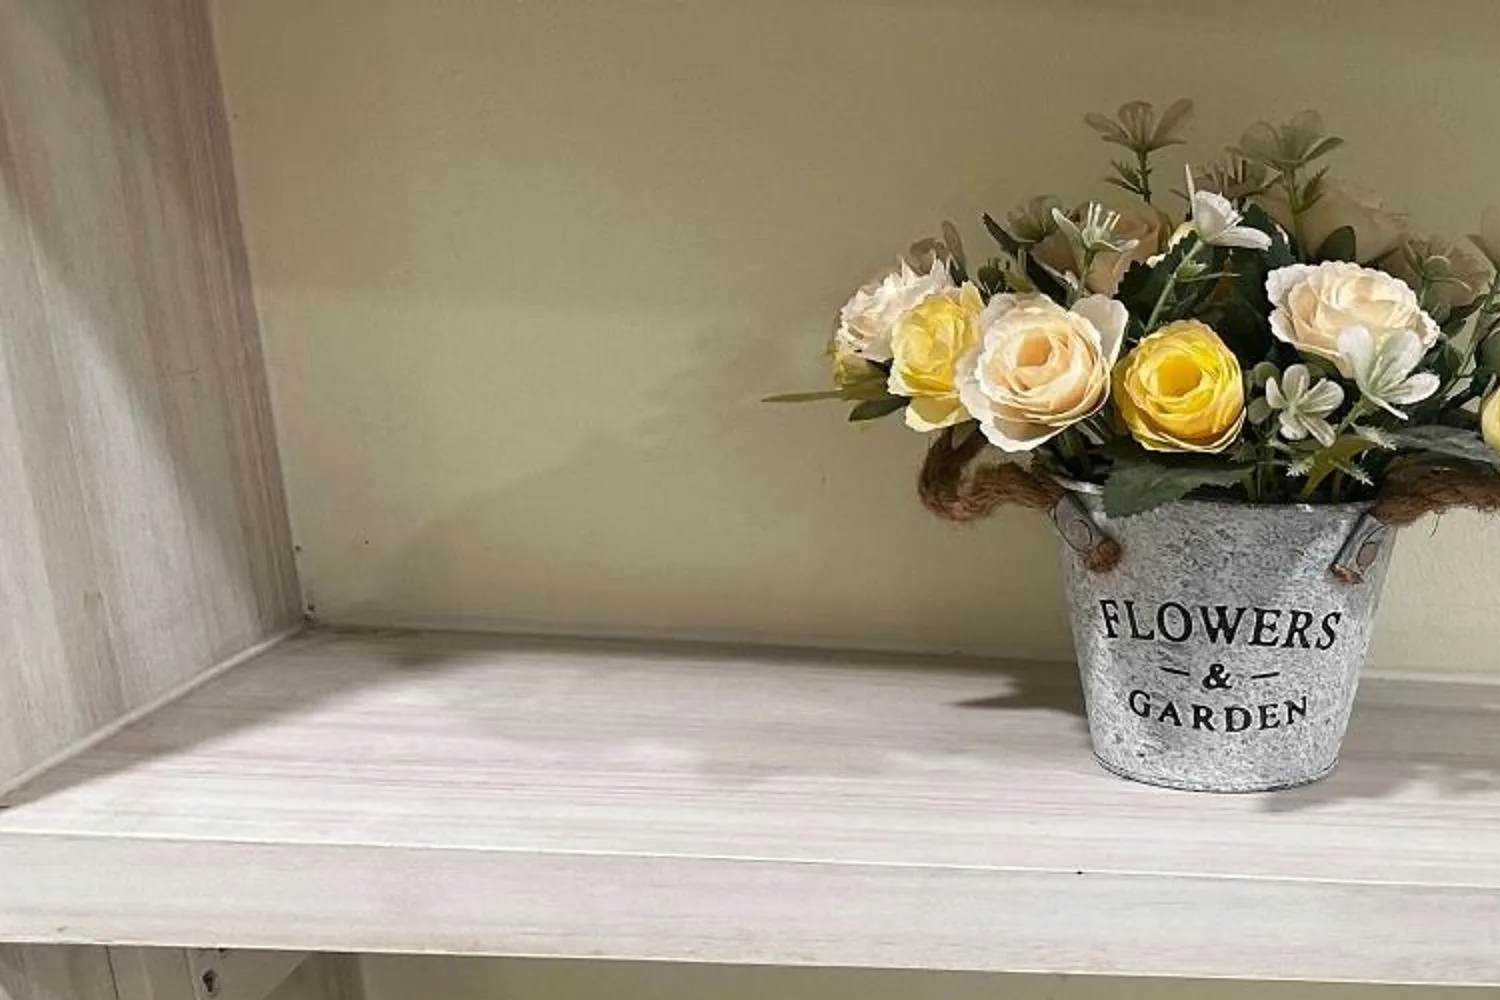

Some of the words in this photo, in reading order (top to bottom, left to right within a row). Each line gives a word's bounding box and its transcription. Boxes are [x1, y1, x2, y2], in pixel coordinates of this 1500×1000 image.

[1100, 599, 1342, 650] FLOWERS
[1202, 663, 1232, 690] &
[1128, 689, 1307, 732] GARDEN
